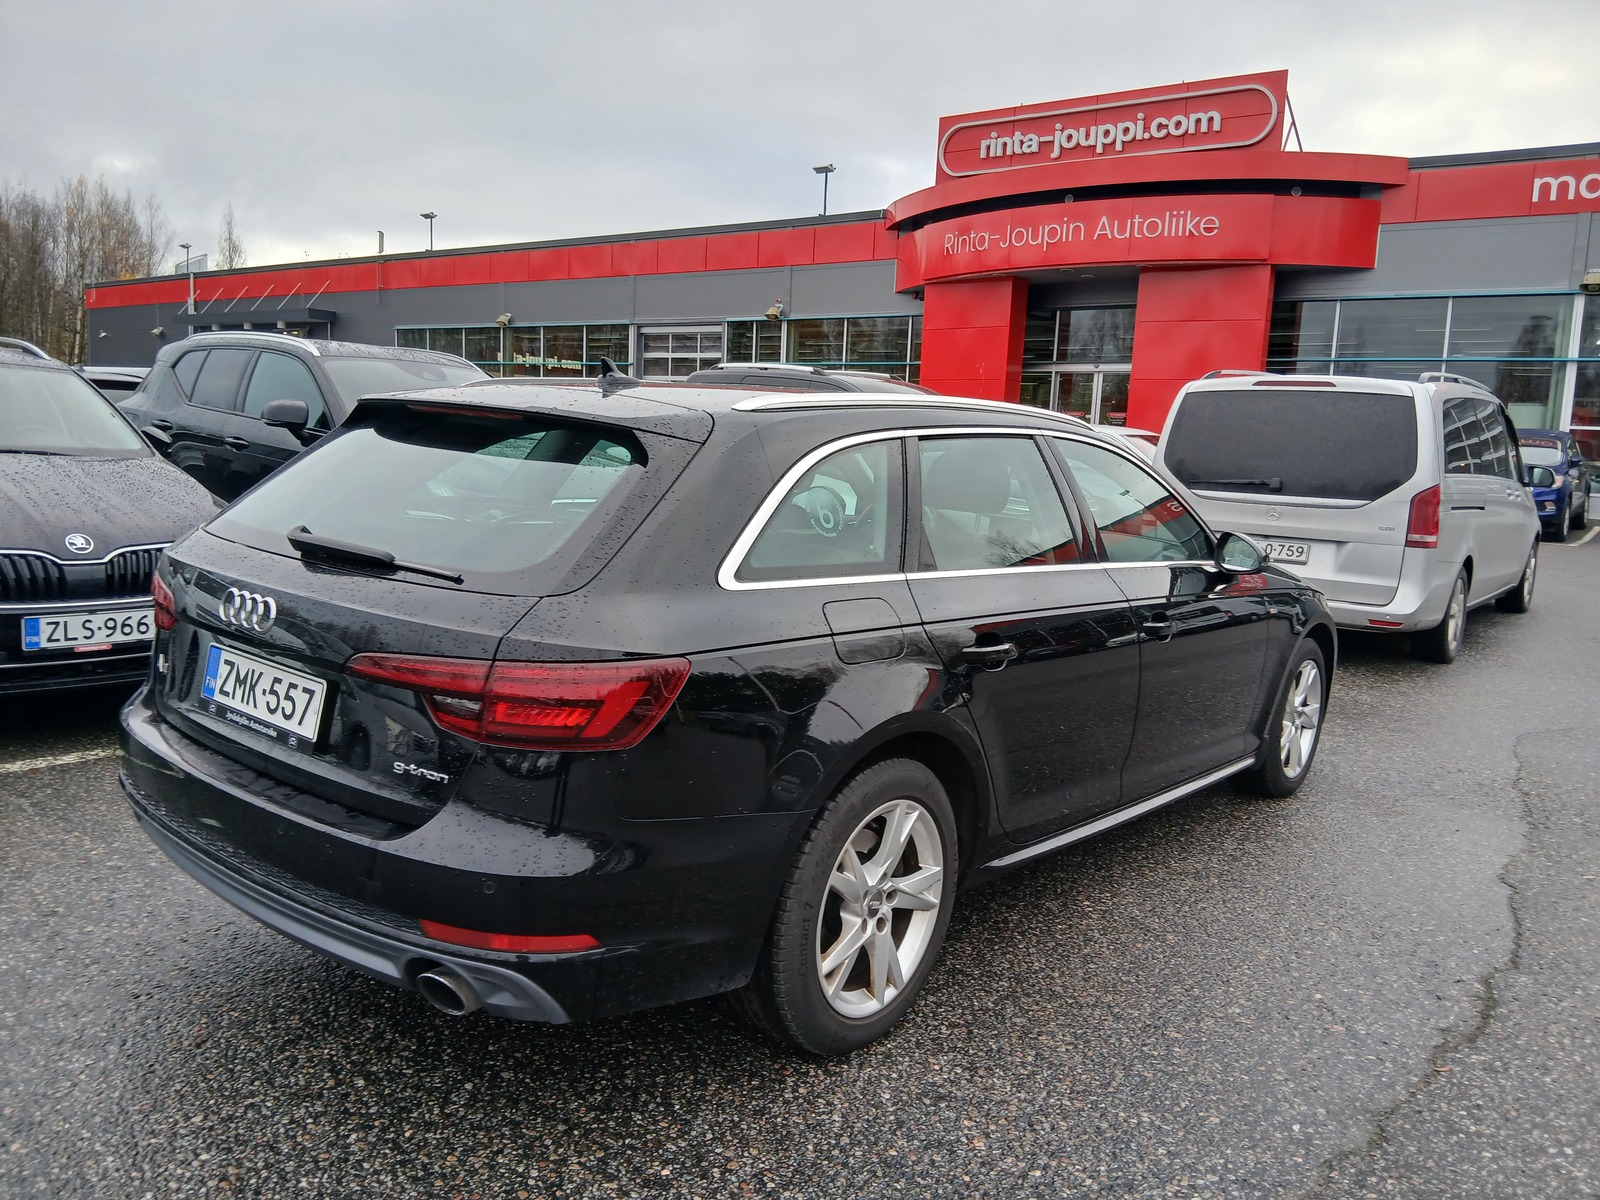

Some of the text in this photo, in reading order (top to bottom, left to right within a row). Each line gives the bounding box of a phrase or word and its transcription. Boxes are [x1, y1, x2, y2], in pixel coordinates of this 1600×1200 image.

[979, 110, 1221, 159] rinta-jouppi.com
[943, 210, 1220, 256] Rinta-Joupin Autoliike
[45, 614, 150, 643] ZLS-966
[219, 658, 316, 727] ZMK-557
[393, 761, 449, 783] g-tron
